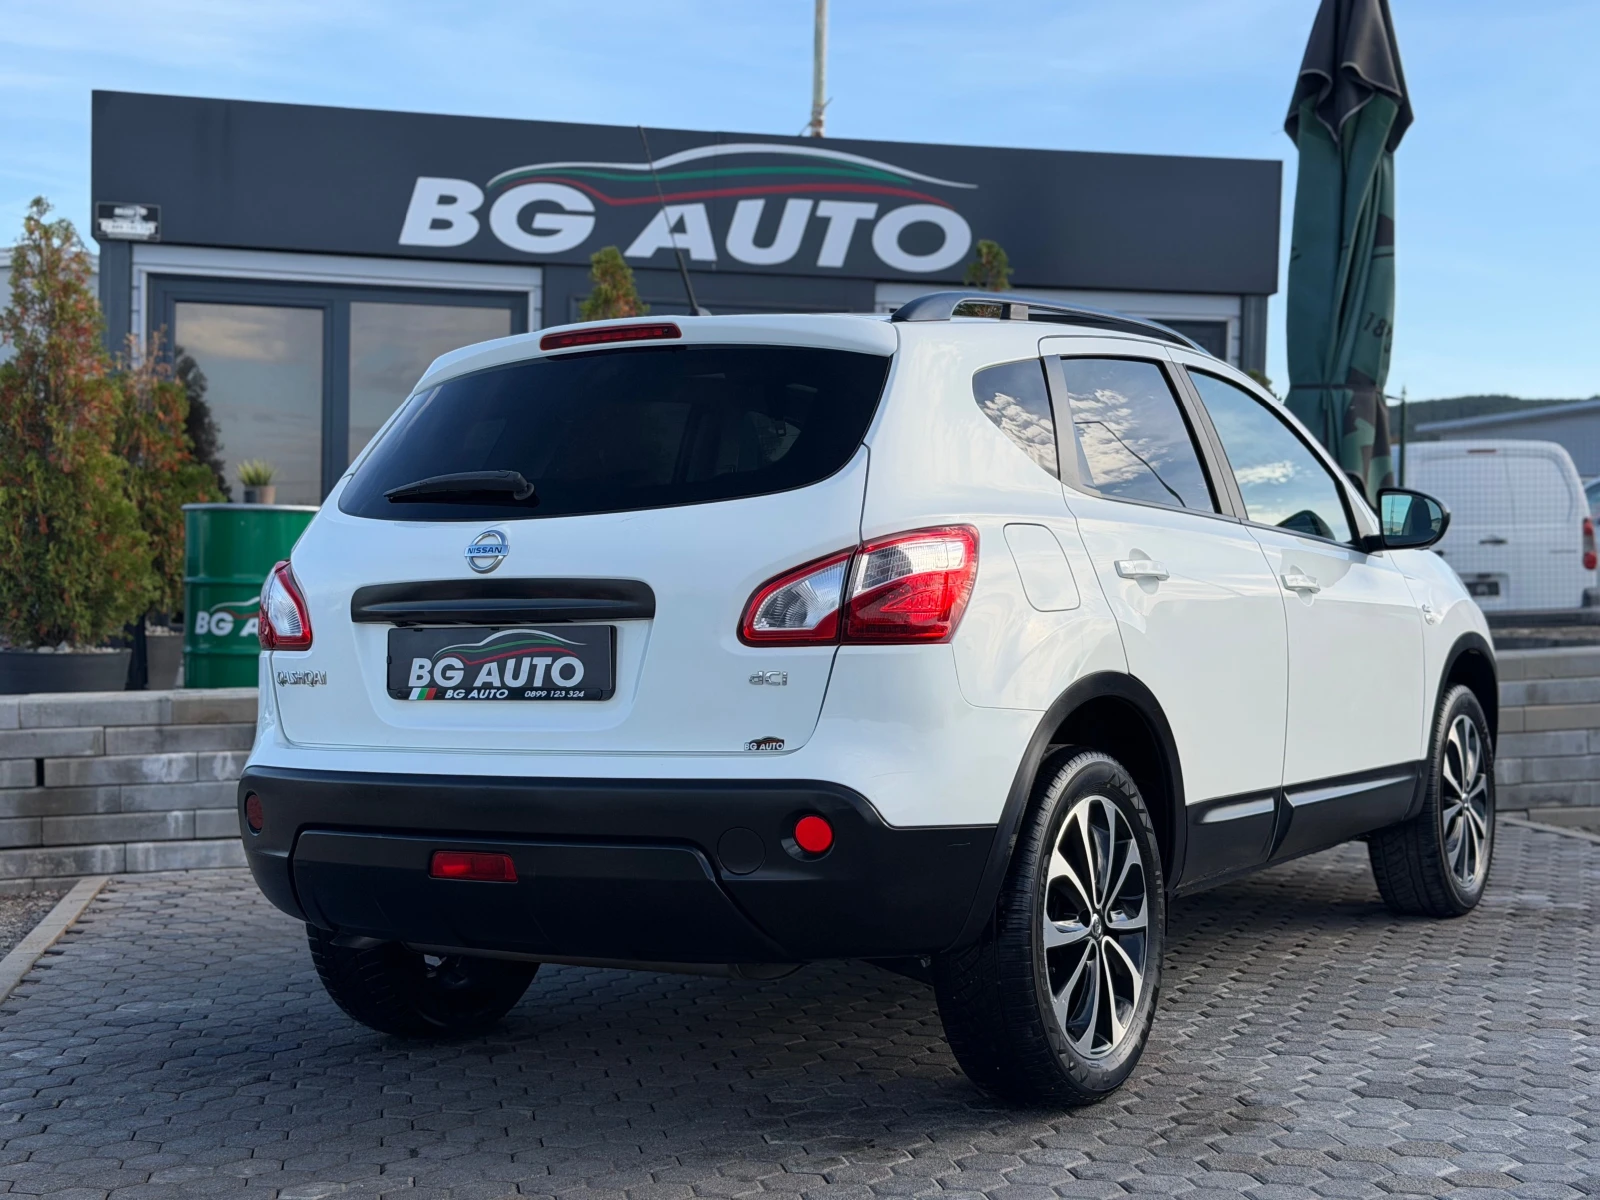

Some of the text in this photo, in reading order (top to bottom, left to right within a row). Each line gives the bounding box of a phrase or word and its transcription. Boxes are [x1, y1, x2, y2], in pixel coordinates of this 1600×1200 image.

[398, 176, 972, 272] BG AUTO
[467, 546, 503, 554] NISSAN
[194, 610, 234, 637] BG
[276, 669, 328, 687] QASHQAI
[408, 656, 585, 688] BG AUTO
[444, 689, 585, 699] BG AUTO 0899 123 324
[744, 742, 784, 751] BG AUTO
